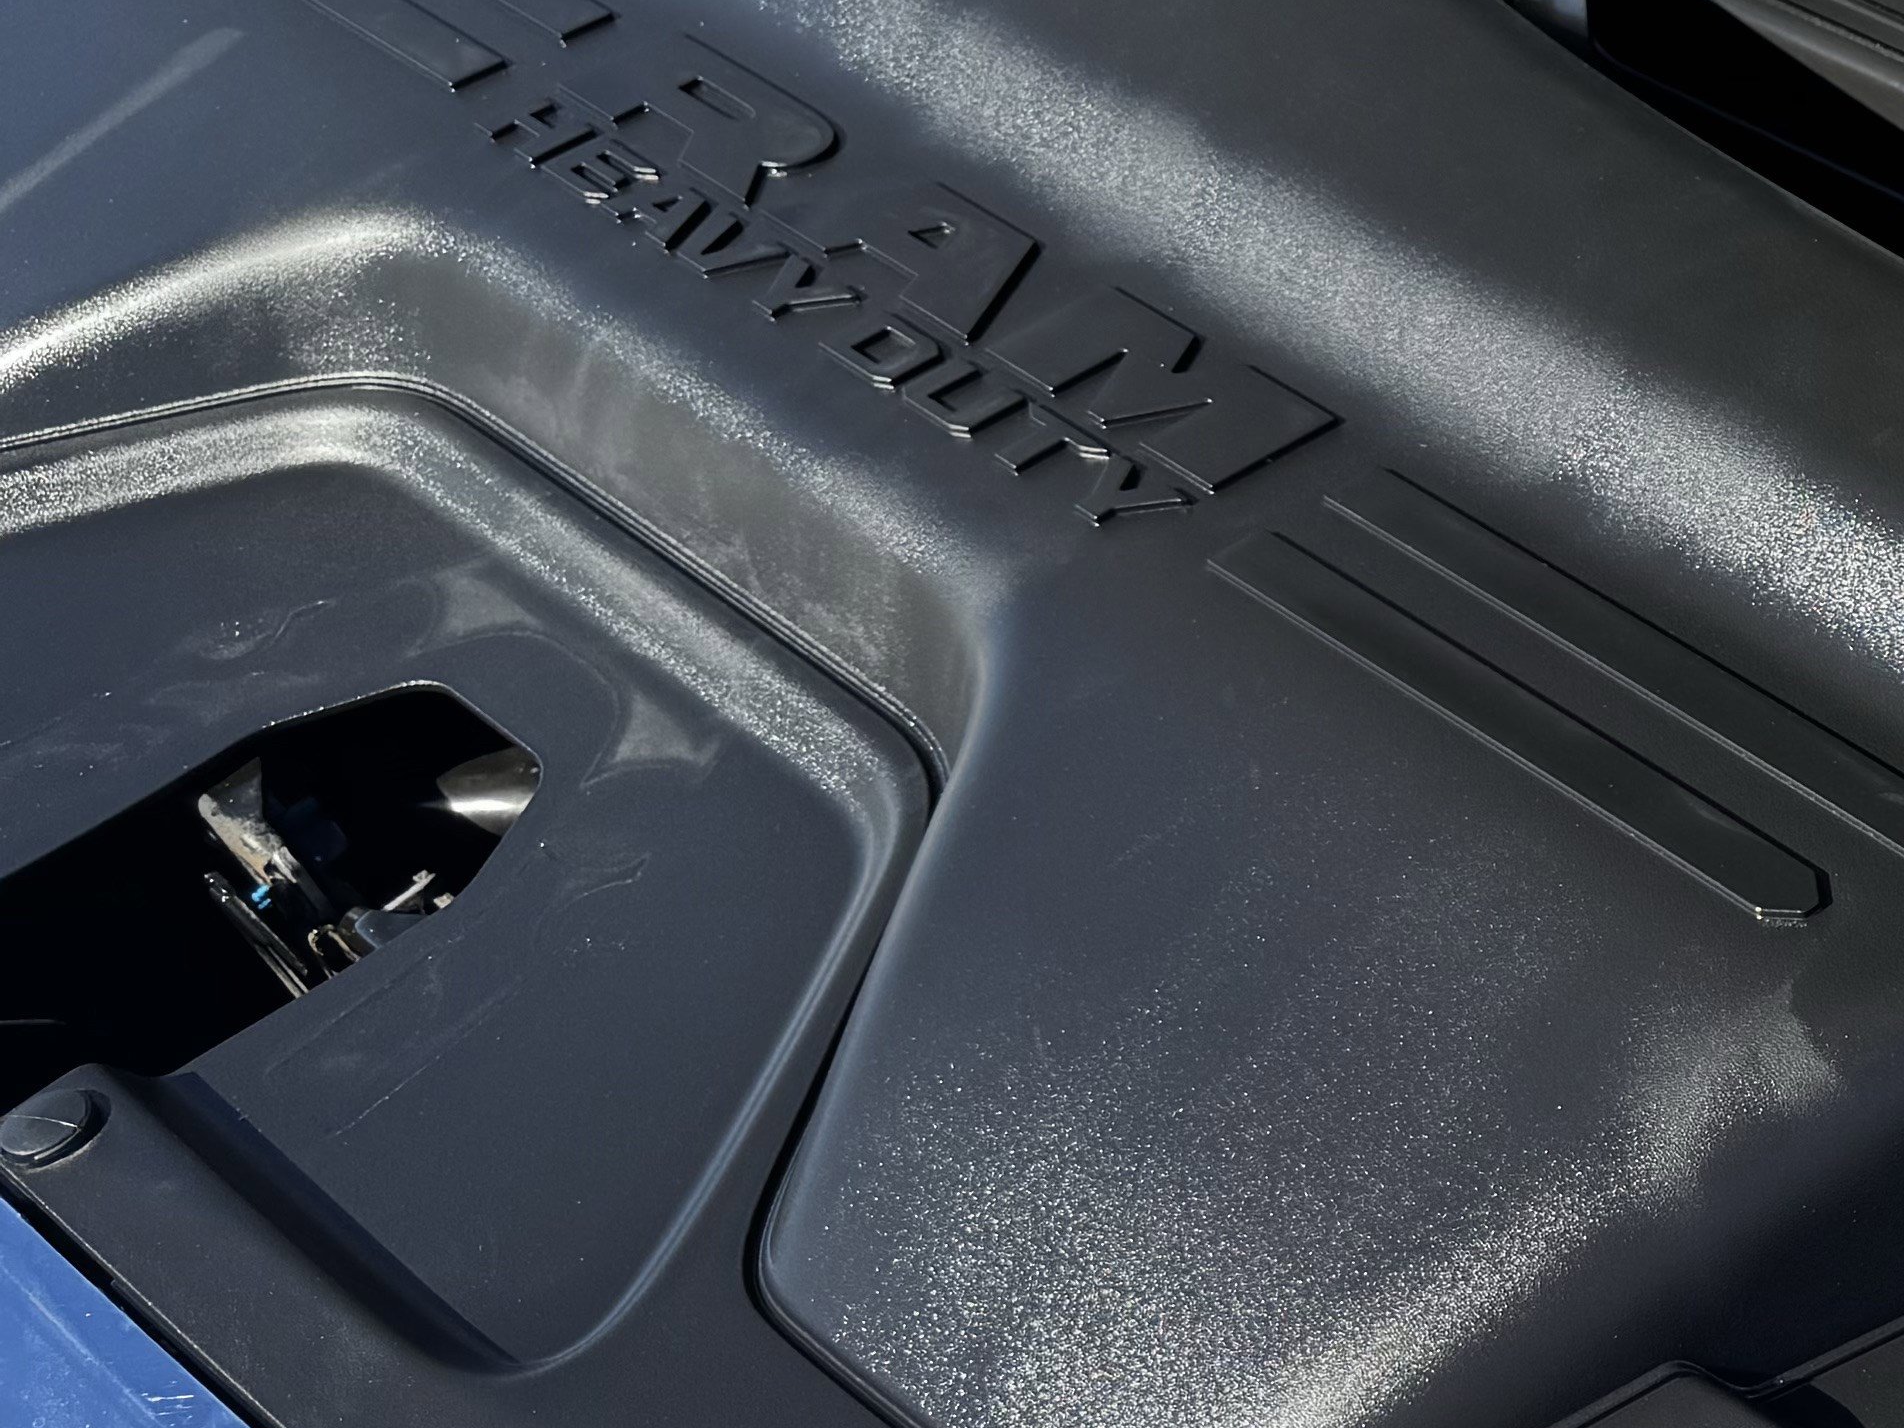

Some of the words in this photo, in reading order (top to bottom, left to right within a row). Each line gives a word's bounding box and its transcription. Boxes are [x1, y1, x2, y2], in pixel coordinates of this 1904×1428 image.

[475, 84, 867, 322] HEAVY
[819, 314, 1196, 528] DUTY
[556, 31, 1345, 496] RAM
